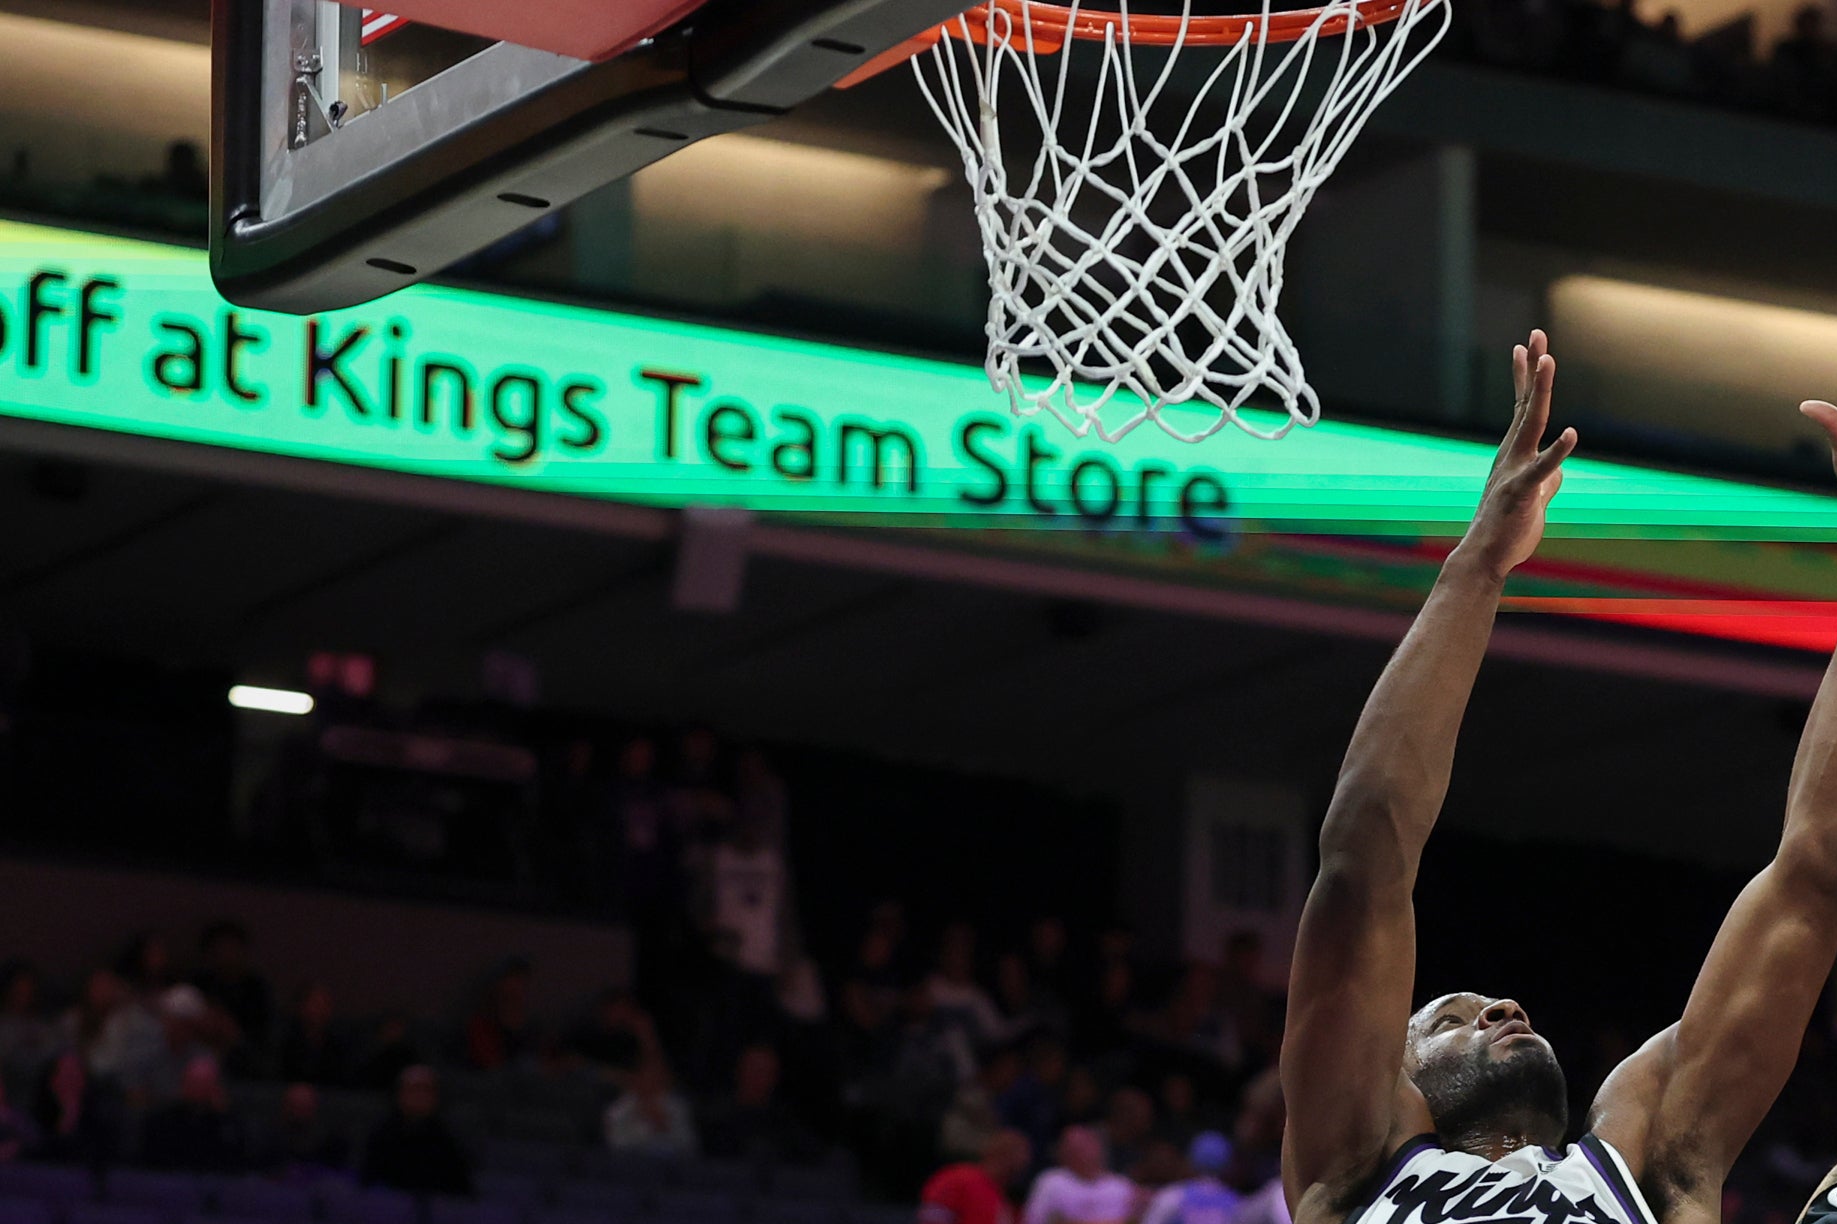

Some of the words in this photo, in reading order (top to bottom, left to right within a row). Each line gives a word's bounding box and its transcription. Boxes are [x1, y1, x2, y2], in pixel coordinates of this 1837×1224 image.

[0, 272, 118, 374] ff
[154, 312, 263, 400] at
[305, 320, 600, 462] Kings
[640, 369, 917, 493] Team
[957, 418, 1234, 541] Store
